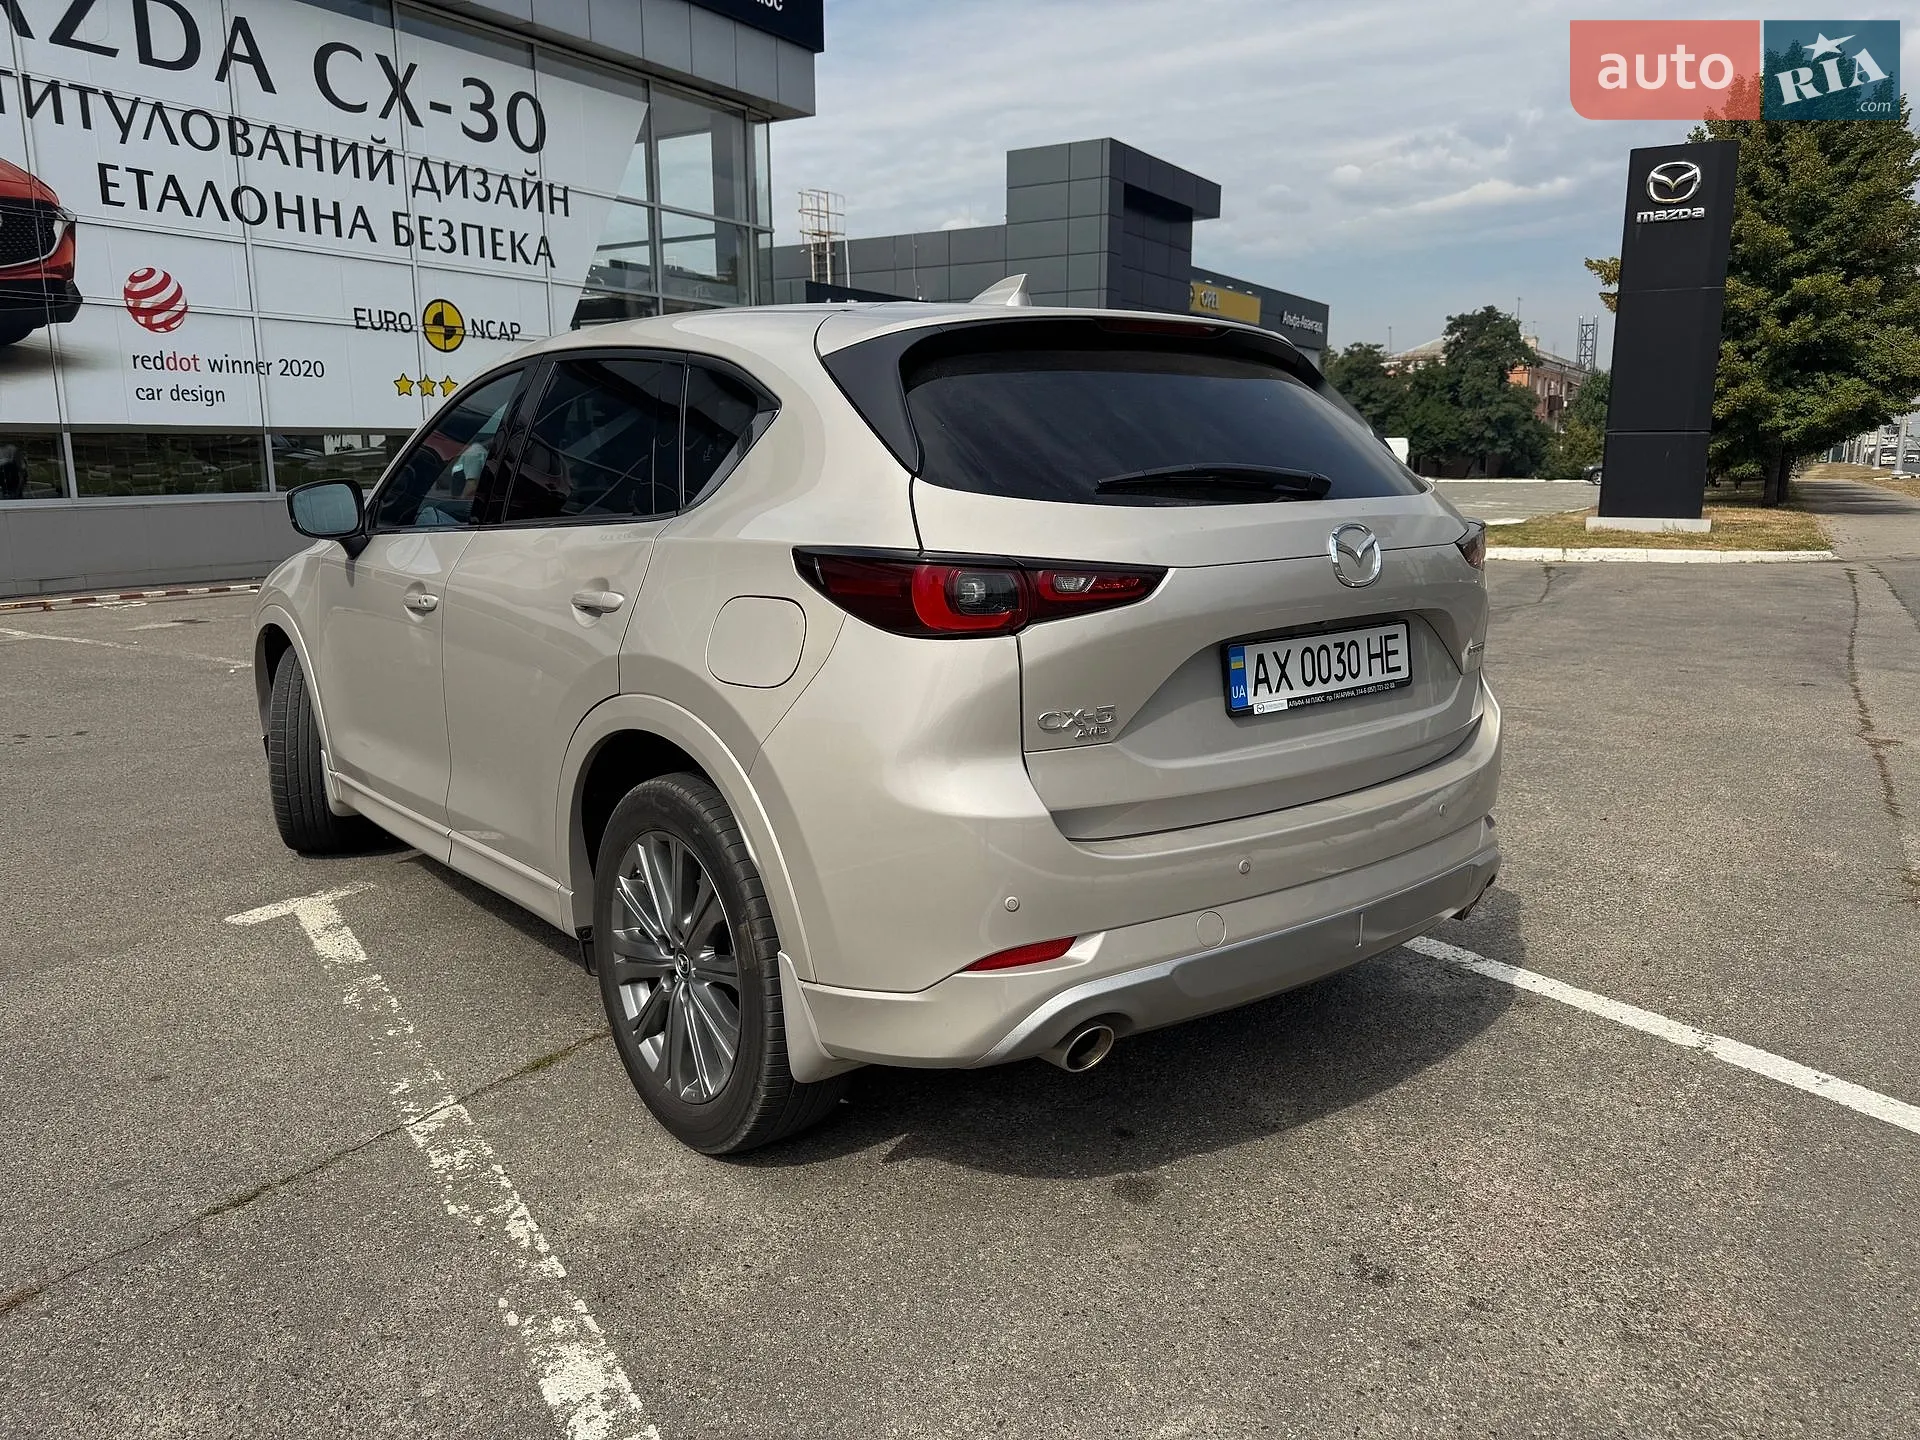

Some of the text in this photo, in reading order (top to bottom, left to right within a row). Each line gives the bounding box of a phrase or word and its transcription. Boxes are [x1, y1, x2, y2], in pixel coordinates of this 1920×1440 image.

[313, 41, 547, 154] CX-30
[411, 157, 570, 217] ДИЗАЙН
[97, 163, 557, 269] ЕТАЛОННА БЕЗПЕКА
[353, 307, 521, 341] EURO NCAP
[208, 354, 272, 375] winner
[279, 358, 325, 378] 2020
[135, 384, 226, 406] car design
[1253, 634, 1402, 697] AX 0030 HE
[1231, 686, 1246, 699] UA
[1038, 704, 1115, 731] CX-5
